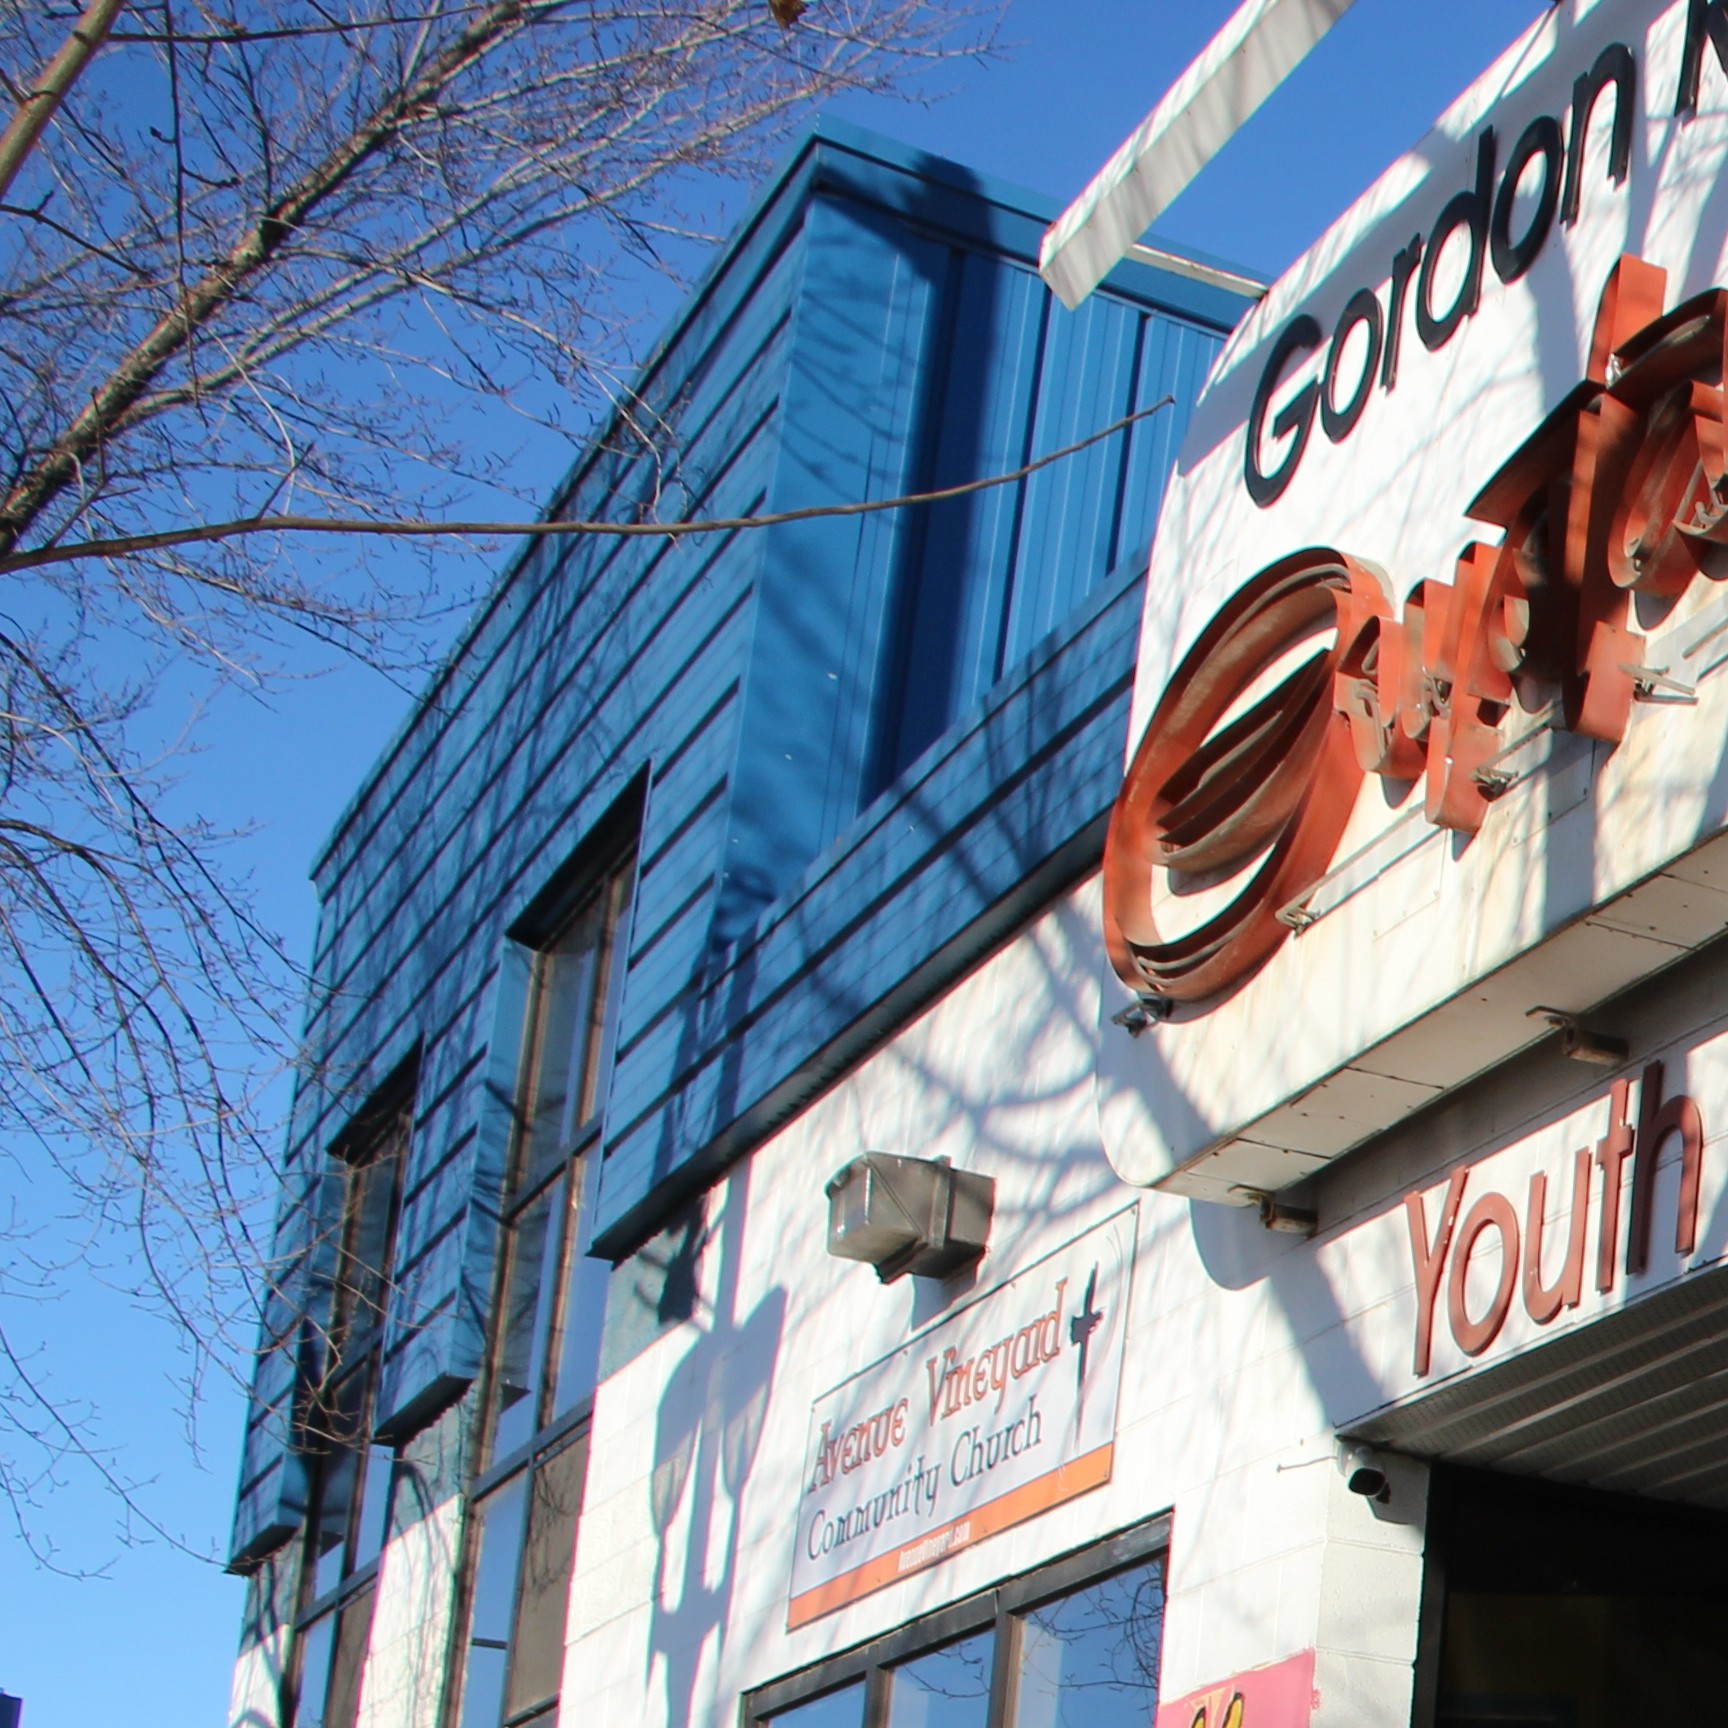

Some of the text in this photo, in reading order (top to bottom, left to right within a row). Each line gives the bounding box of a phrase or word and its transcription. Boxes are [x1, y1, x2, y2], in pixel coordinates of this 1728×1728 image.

[1243, 42, 1633, 508] Gordon
[1402, 1058, 1704, 1376] Youth
[806, 1393, 1043, 1561] Community Church
[807, 1276, 1070, 1496] Avenue Vineyard
